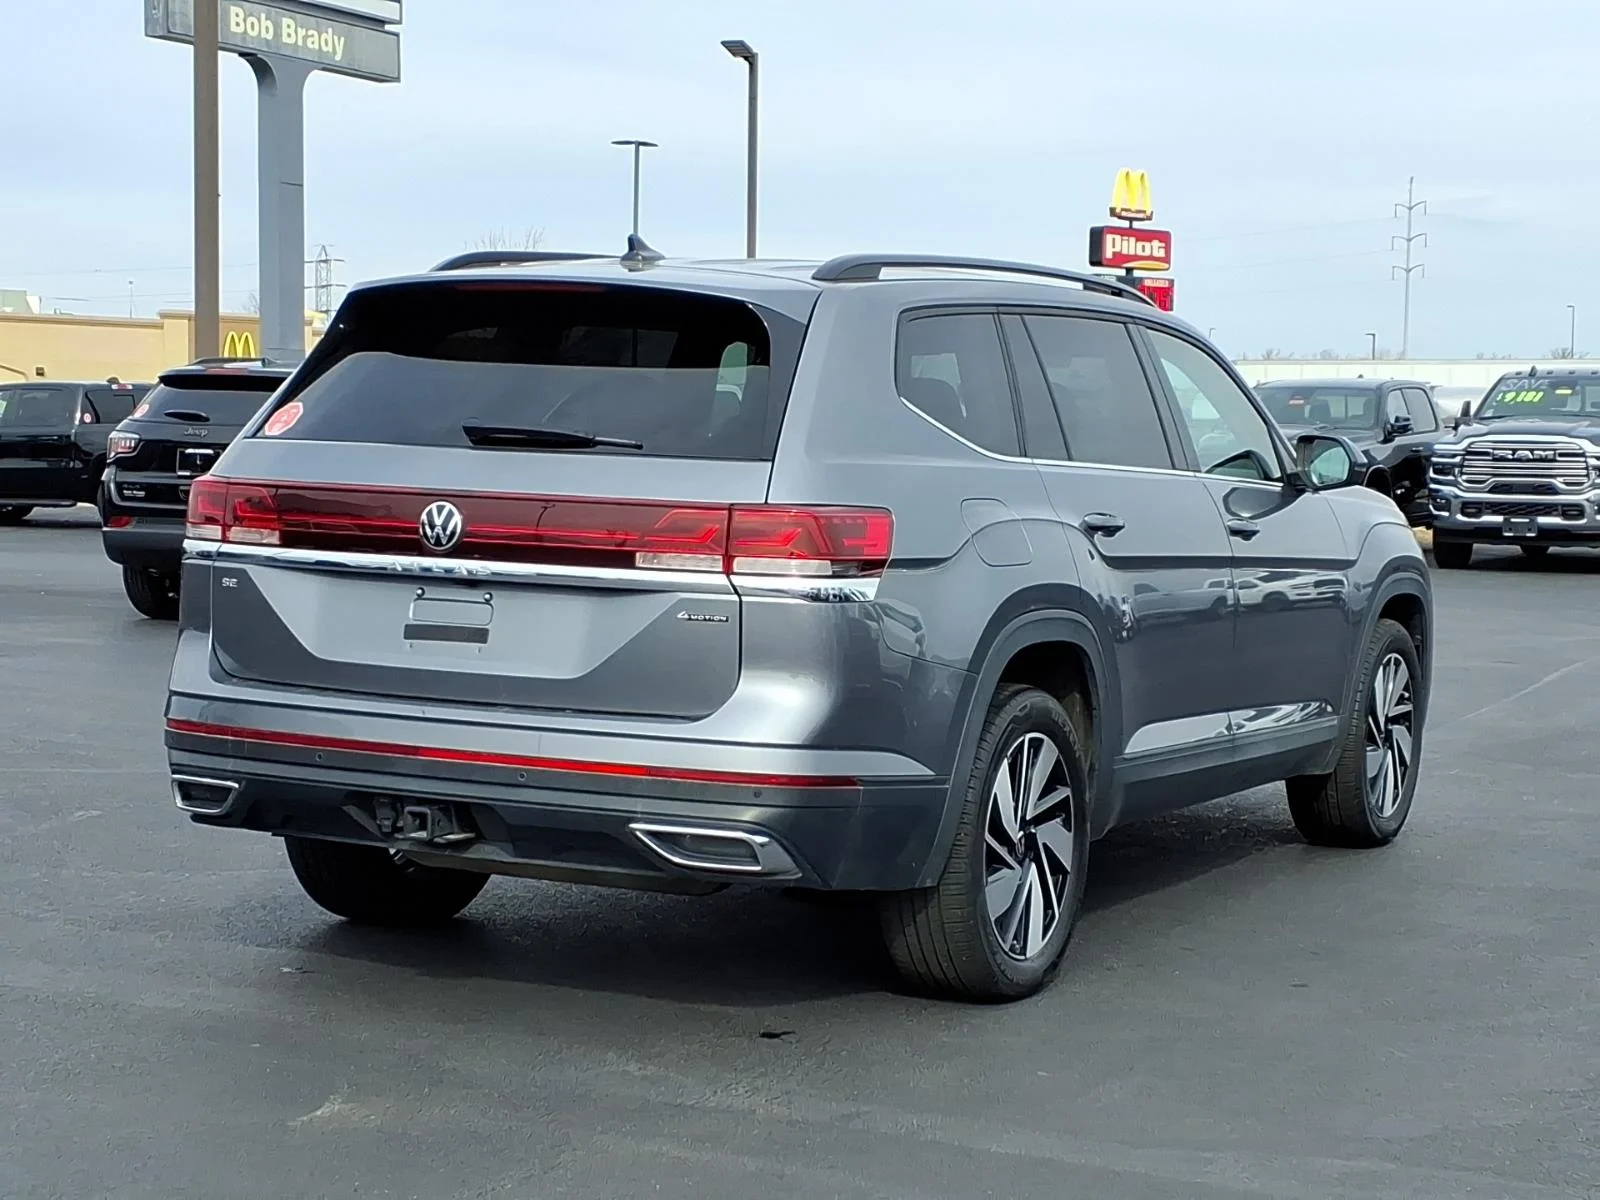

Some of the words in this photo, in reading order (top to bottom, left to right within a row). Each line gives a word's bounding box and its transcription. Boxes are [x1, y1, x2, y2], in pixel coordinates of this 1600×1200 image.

[229, 6, 274, 40] Bob
[281, 17, 346, 61] Brady
[1105, 233, 1166, 259] Pilot
[184, 426, 208, 437] Jeep
[1493, 450, 1554, 460] RAM
[221, 577, 238, 587] SE
[676, 611, 728, 622] 4MOTION
